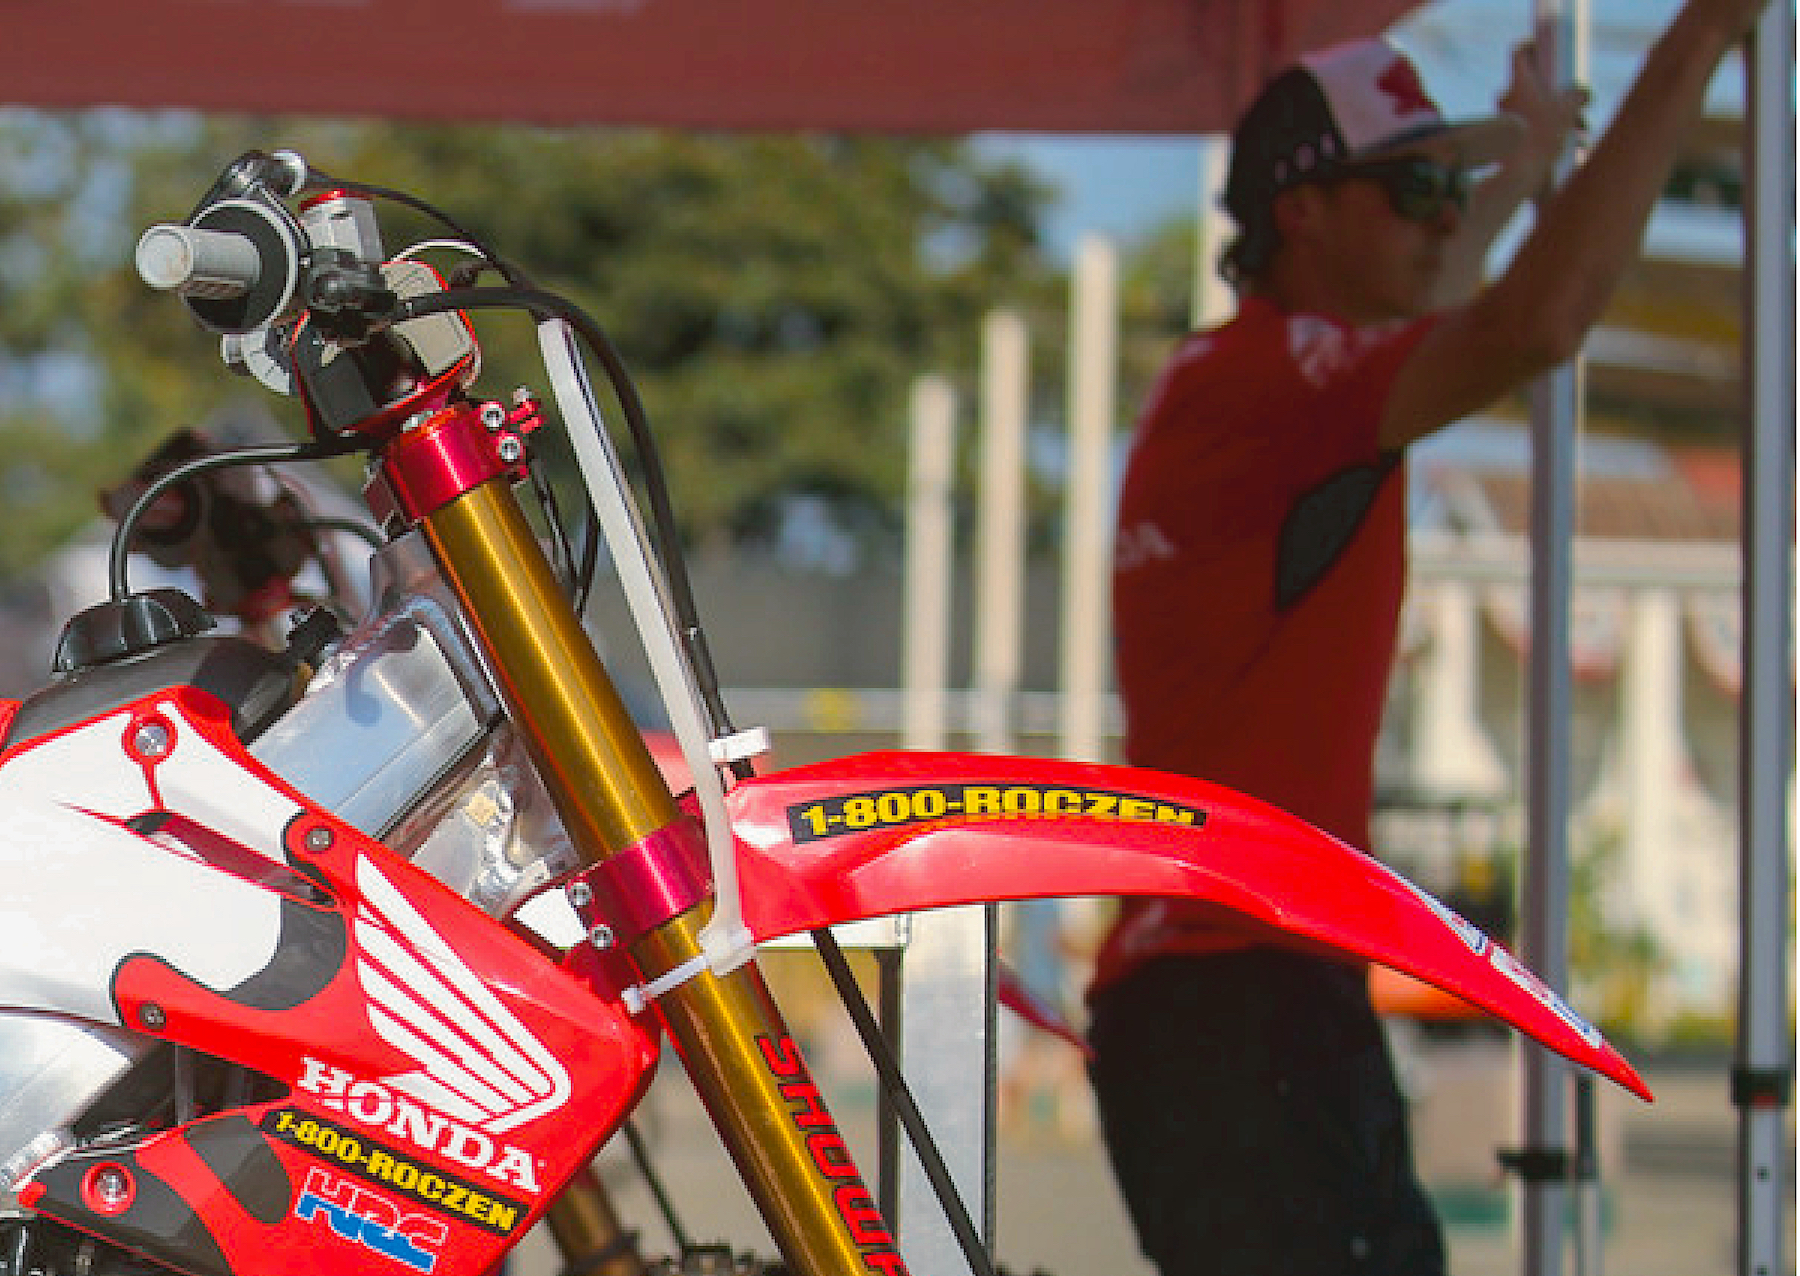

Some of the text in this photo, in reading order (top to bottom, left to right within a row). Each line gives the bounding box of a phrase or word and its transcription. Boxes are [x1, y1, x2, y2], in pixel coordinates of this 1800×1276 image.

[275, 1111, 518, 1231] 1-800-ROCZEN
[298, 1055, 542, 1193] HONDA
[296, 1166, 449, 1274] HRC
